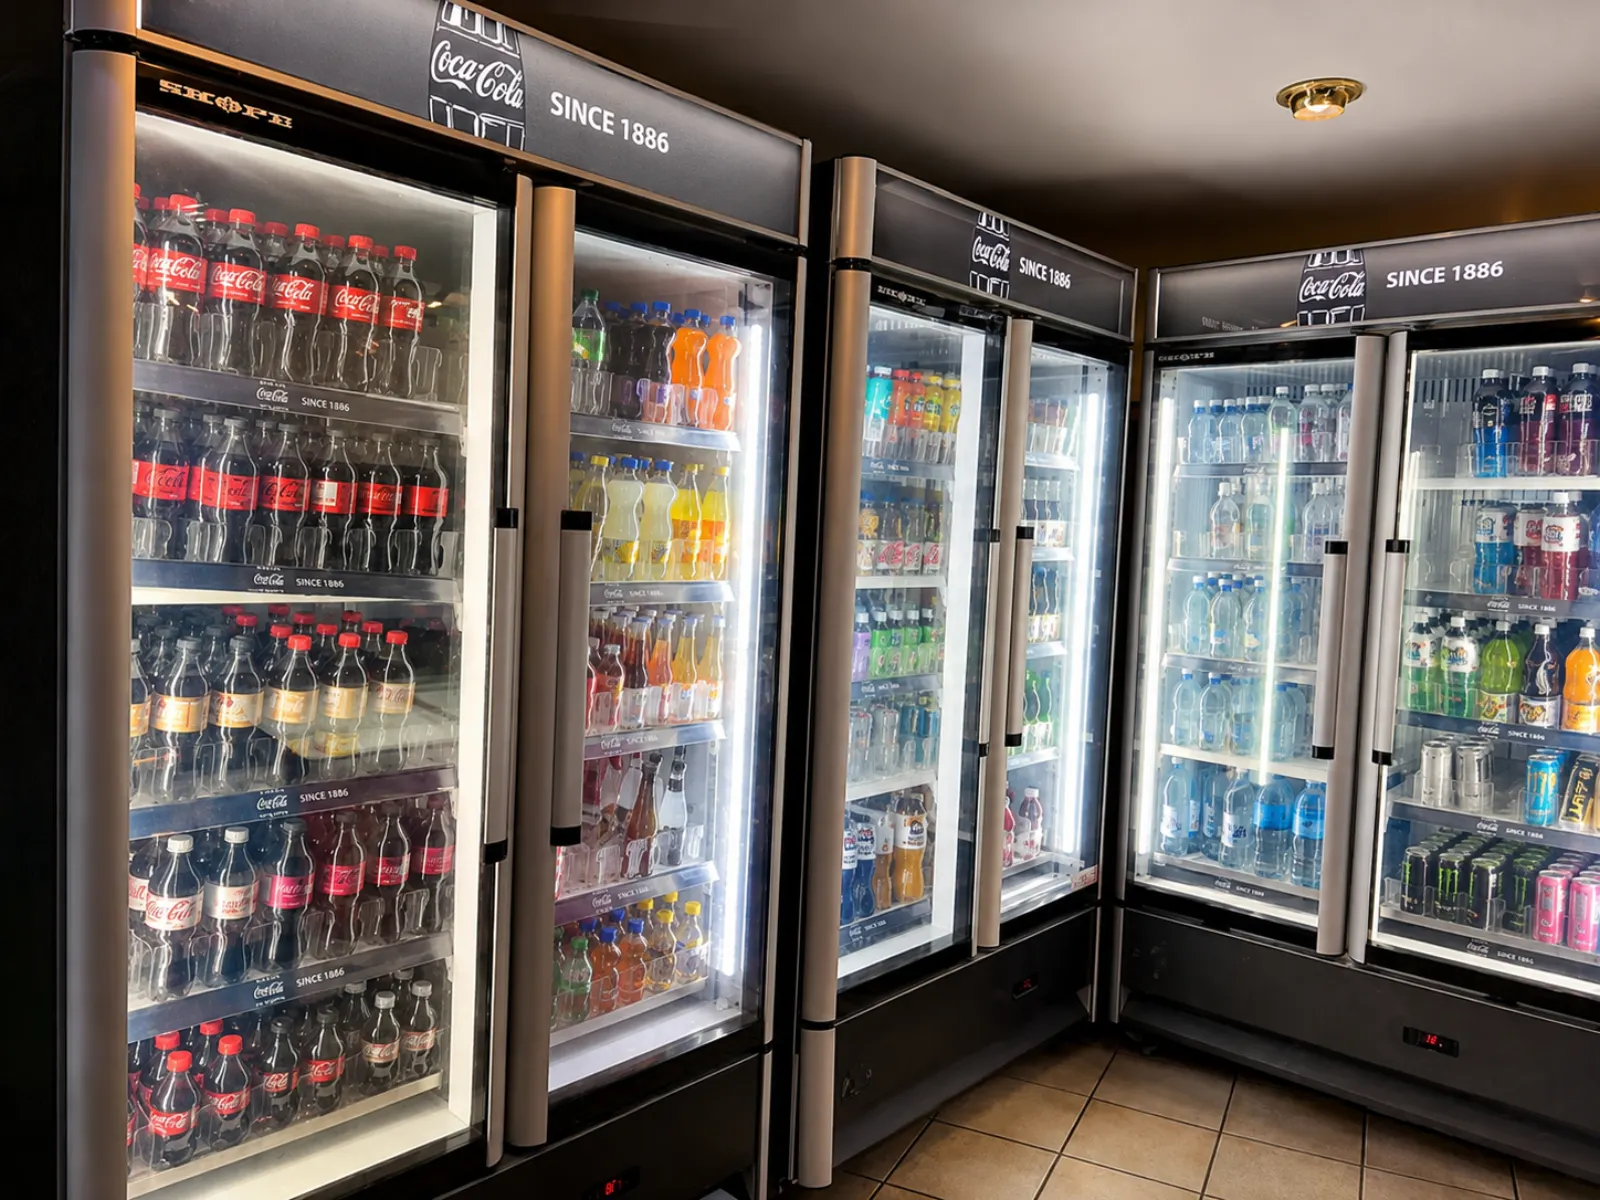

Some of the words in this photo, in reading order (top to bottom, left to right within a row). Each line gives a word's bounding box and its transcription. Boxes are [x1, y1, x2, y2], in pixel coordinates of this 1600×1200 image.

[431, 40, 525, 110] Coca-Cola
[550, 91, 615, 135] SINCE
[620, 118, 670, 153] 1886
[971, 235, 1010, 273] Coca-Cola
[1019, 256, 1047, 282] SINCE
[1049, 267, 1071, 289] 1886
[1299, 270, 1366, 303] Coca-Cola
[1386, 266, 1446, 288] SINCE
[1451, 260, 1504, 281] 1886
[301, 396, 327, 409] SINCE
[329, 401, 350, 412] 1886
[295, 577, 322, 587] SINCE
[323, 579, 345, 588] 1886
[299, 791, 326, 803] SINCE
[327, 788, 349, 799] 1886
[296, 972, 323, 988] SINCE
[324, 967, 345, 980] 1886
